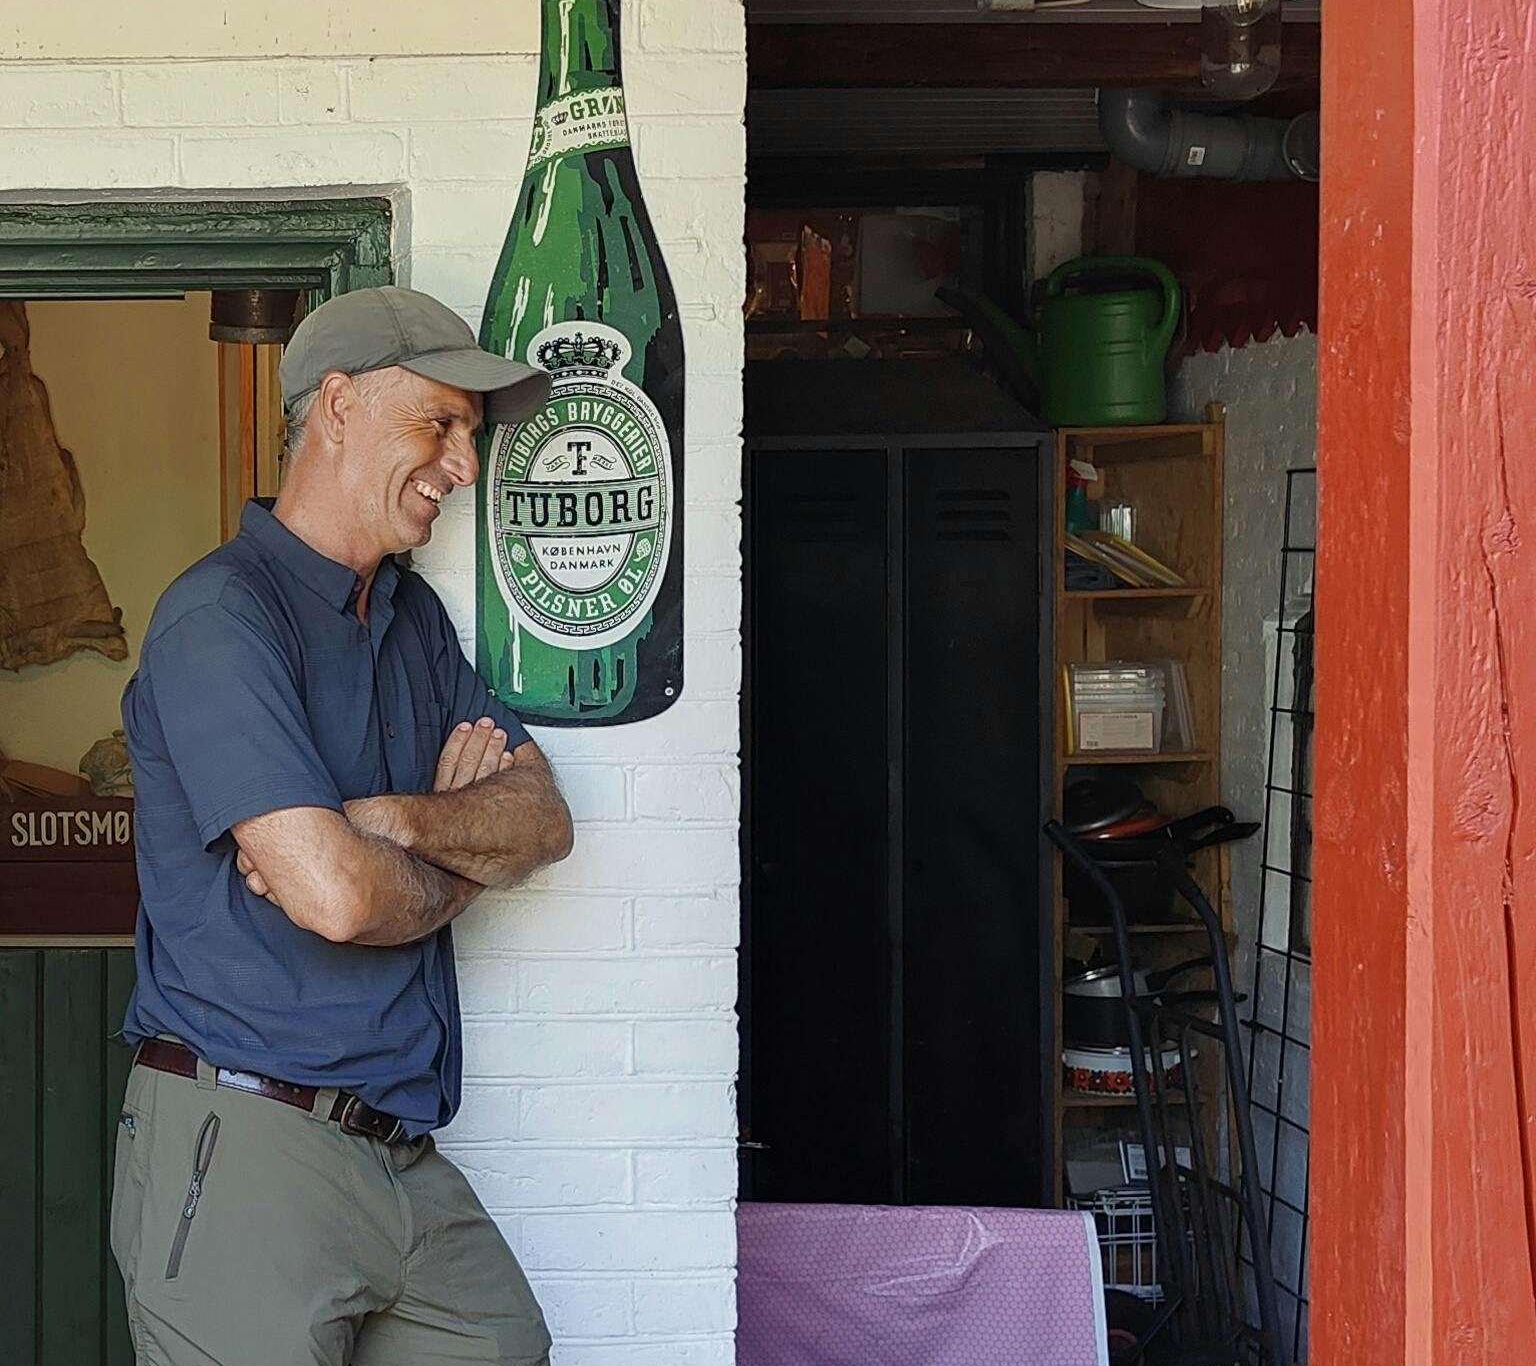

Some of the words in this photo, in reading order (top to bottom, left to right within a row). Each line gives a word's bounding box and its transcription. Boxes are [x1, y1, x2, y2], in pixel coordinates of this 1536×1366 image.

[508, 407, 559, 474] TUBORGS
[567, 401, 652, 472] BRYGGERIER
[506, 485, 654, 527] TUBORG
[542, 543, 621, 556] KØBENHAVN
[550, 559, 614, 570] DANMARK
[521, 570, 617, 617] PILSNER
[617, 568, 643, 595] ØL
[11, 811, 130, 847] SLOTSMØ
